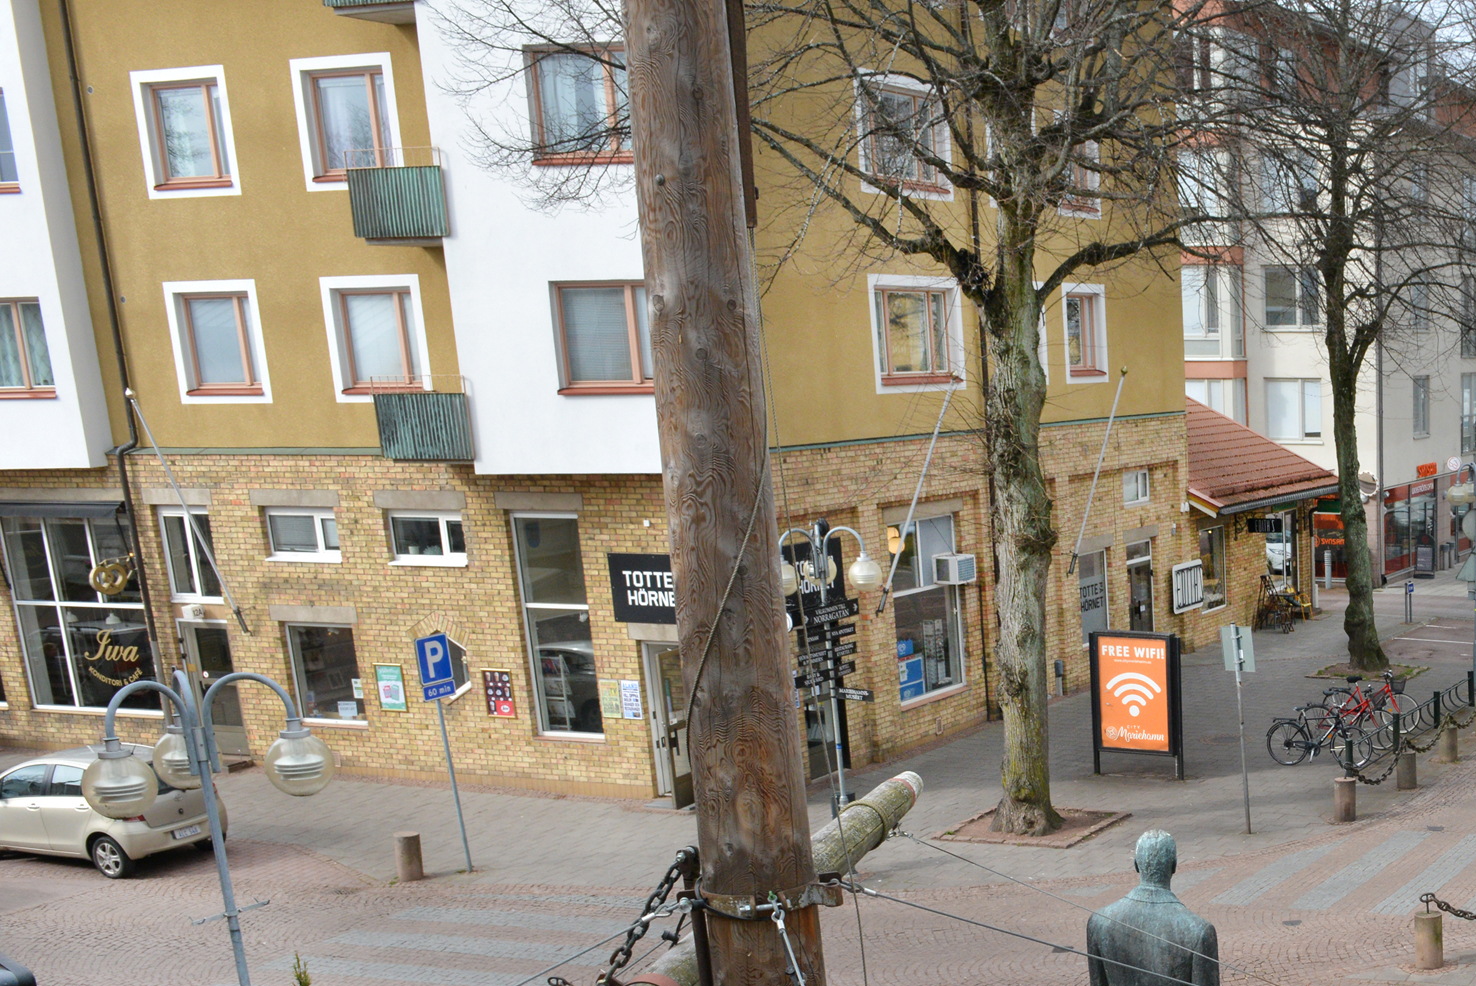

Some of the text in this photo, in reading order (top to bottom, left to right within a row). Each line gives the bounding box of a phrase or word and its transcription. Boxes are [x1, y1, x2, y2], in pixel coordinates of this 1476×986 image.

[622, 570, 674, 588] TOTTE
[627, 588, 676, 607] HÖRNE
[84, 629, 140, 663] Iwa
[1101, 644, 1165, 660] FREE WIFI!
[424, 640, 444, 679] P
[88, 665, 123, 687] KONDITORI
[128, 667, 143, 683] CAFÉ
[428, 685, 451, 697] 60 min
[1114, 725, 1165, 743] Mariehamn
